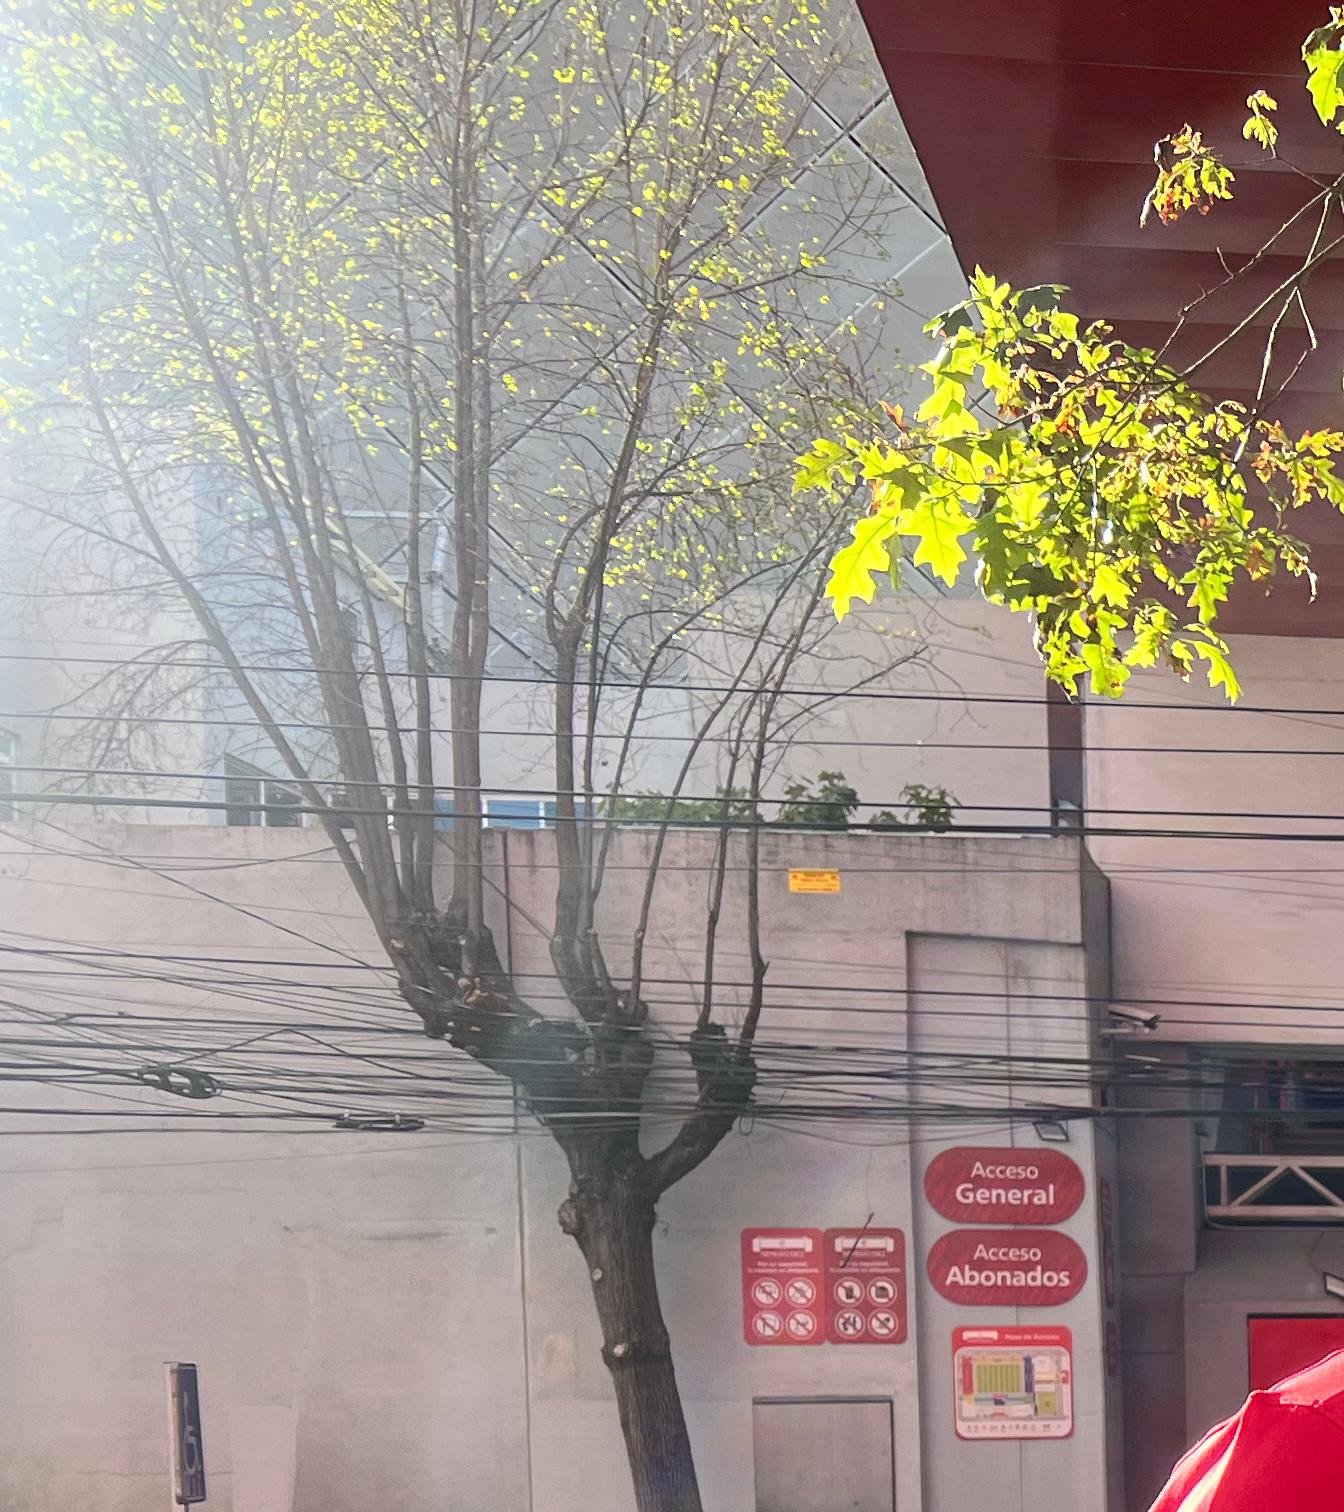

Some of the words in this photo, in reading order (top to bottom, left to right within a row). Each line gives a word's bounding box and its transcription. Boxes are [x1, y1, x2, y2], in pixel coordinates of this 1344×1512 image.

[970, 1161, 1039, 1179] Acceso
[955, 1183, 1056, 1206] General
[973, 1244, 1042, 1262] Acceso
[945, 1264, 1071, 1287] Abonados
